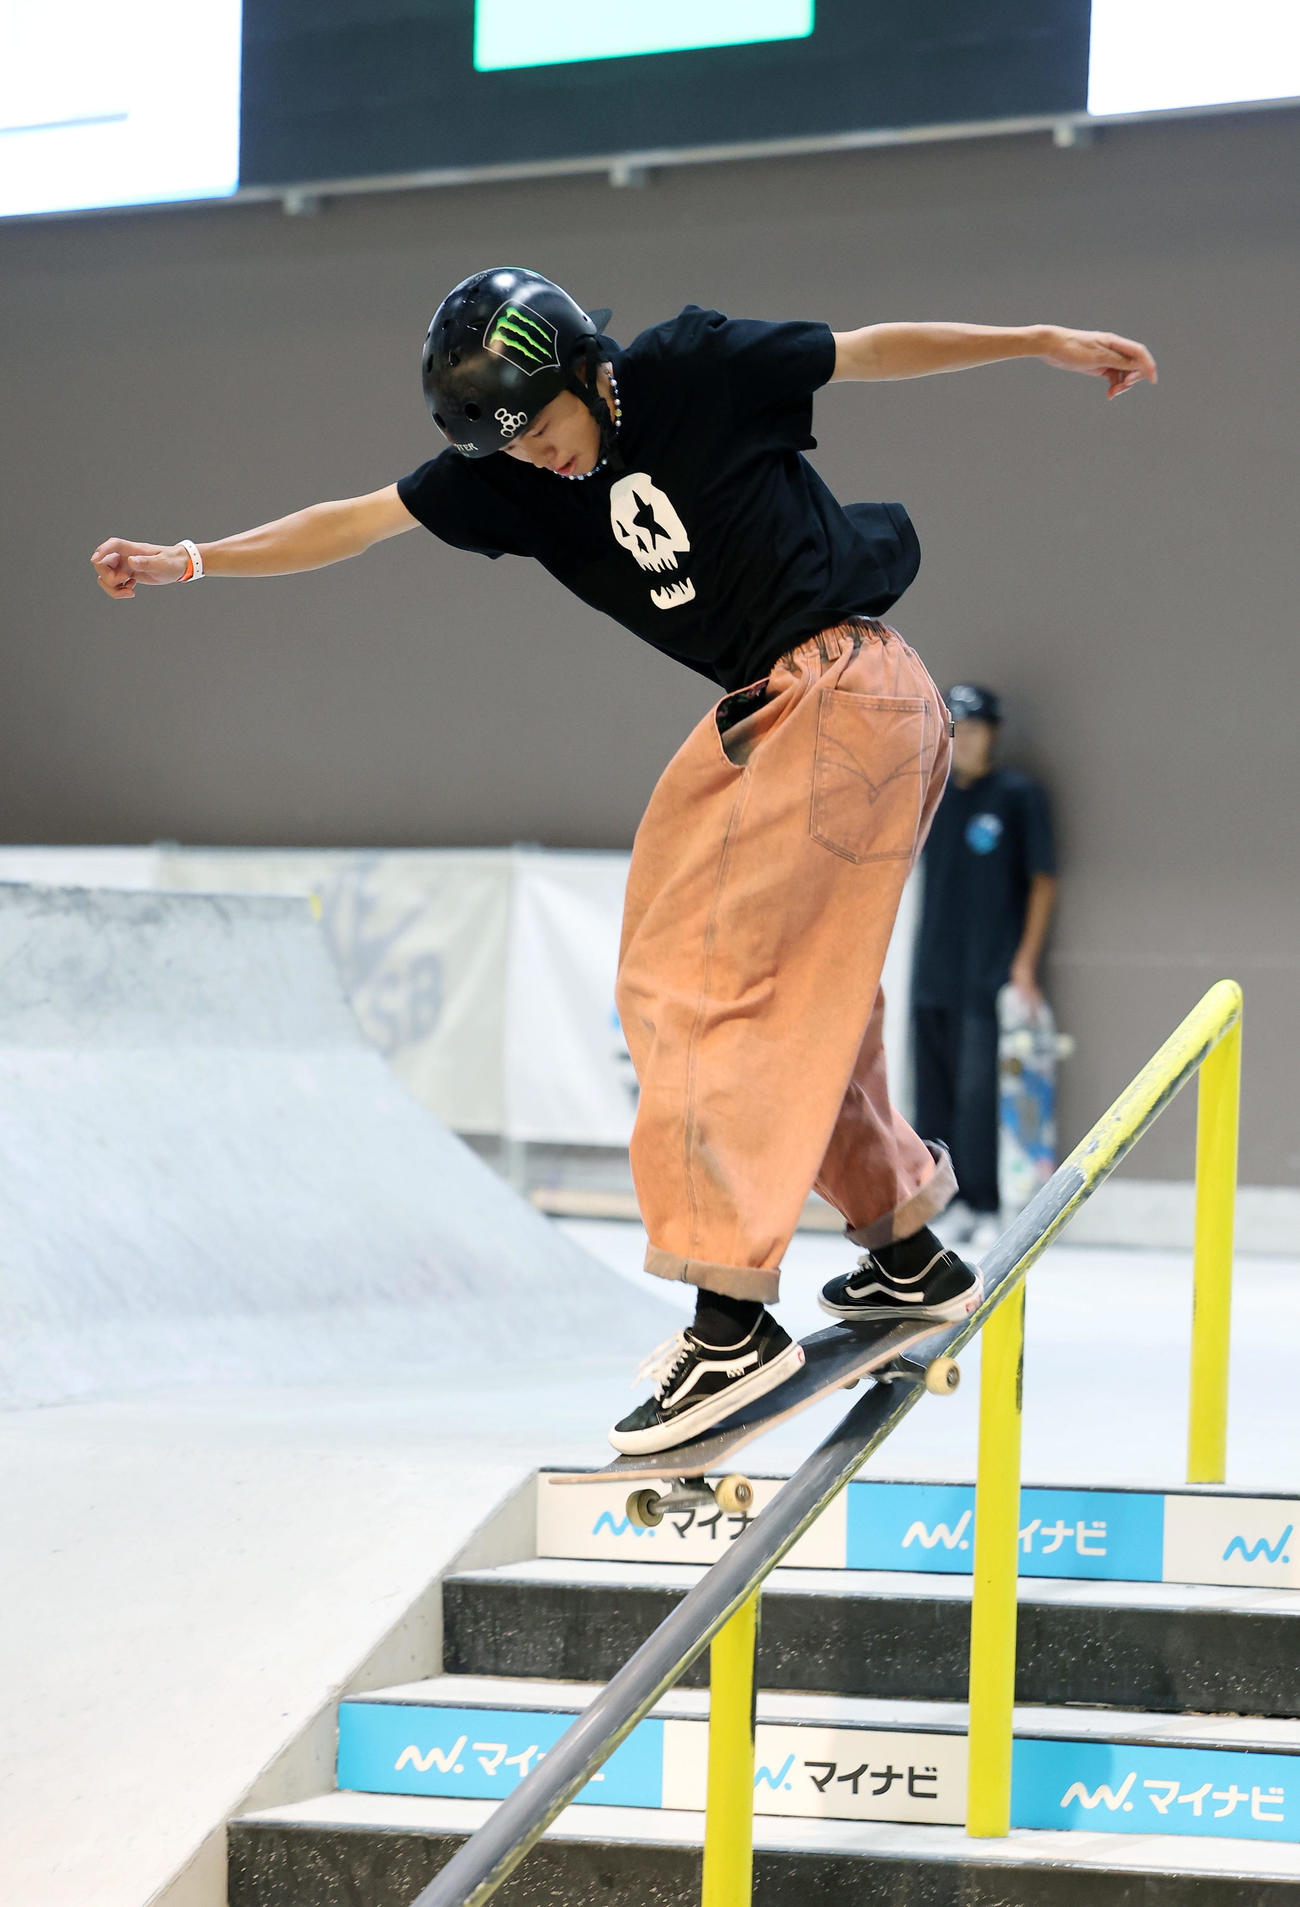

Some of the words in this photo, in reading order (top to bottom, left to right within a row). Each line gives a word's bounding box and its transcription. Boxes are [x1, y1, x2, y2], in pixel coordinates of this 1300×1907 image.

[665, 1508, 757, 1540] マイナ
[1018, 1518, 1107, 1556] イナビ
[804, 1761, 938, 1799] マイナビ
[1143, 1779, 1285, 1822] マイナビ
